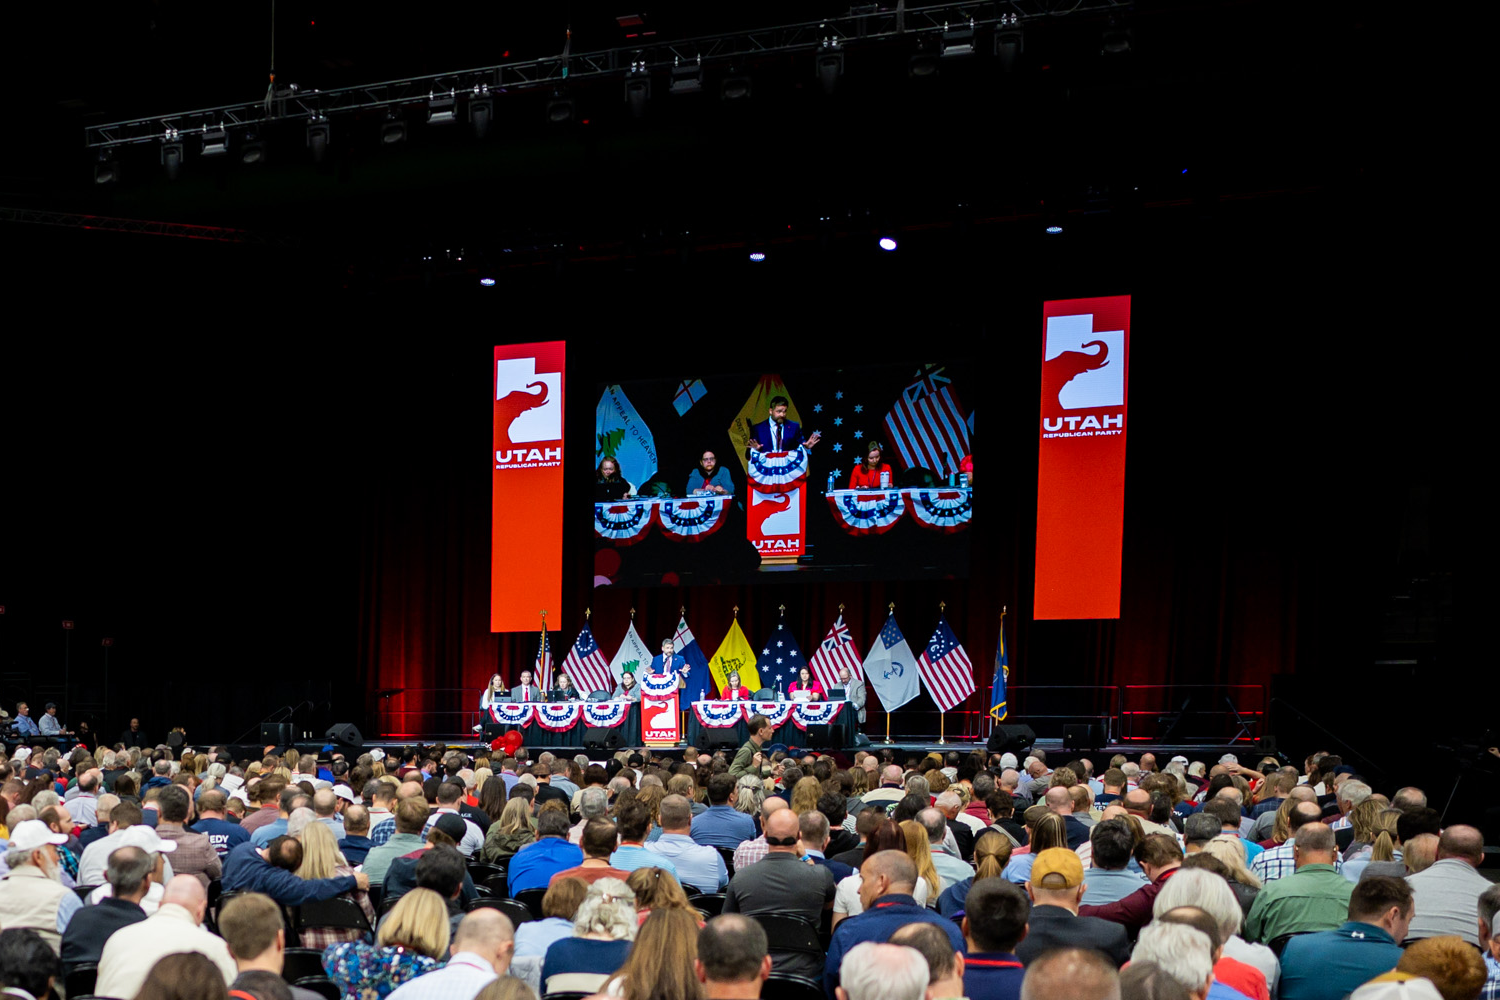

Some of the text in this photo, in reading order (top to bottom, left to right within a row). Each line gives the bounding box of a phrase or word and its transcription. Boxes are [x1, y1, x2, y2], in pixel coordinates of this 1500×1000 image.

[612, 396, 631, 426] APPEAL
[629, 425, 639, 436] TO
[637, 436, 657, 464] HEAVEN
[1043, 414, 1123, 431] UTAH
[495, 447, 561, 463] UTAH
[752, 539, 799, 549] UTAH
